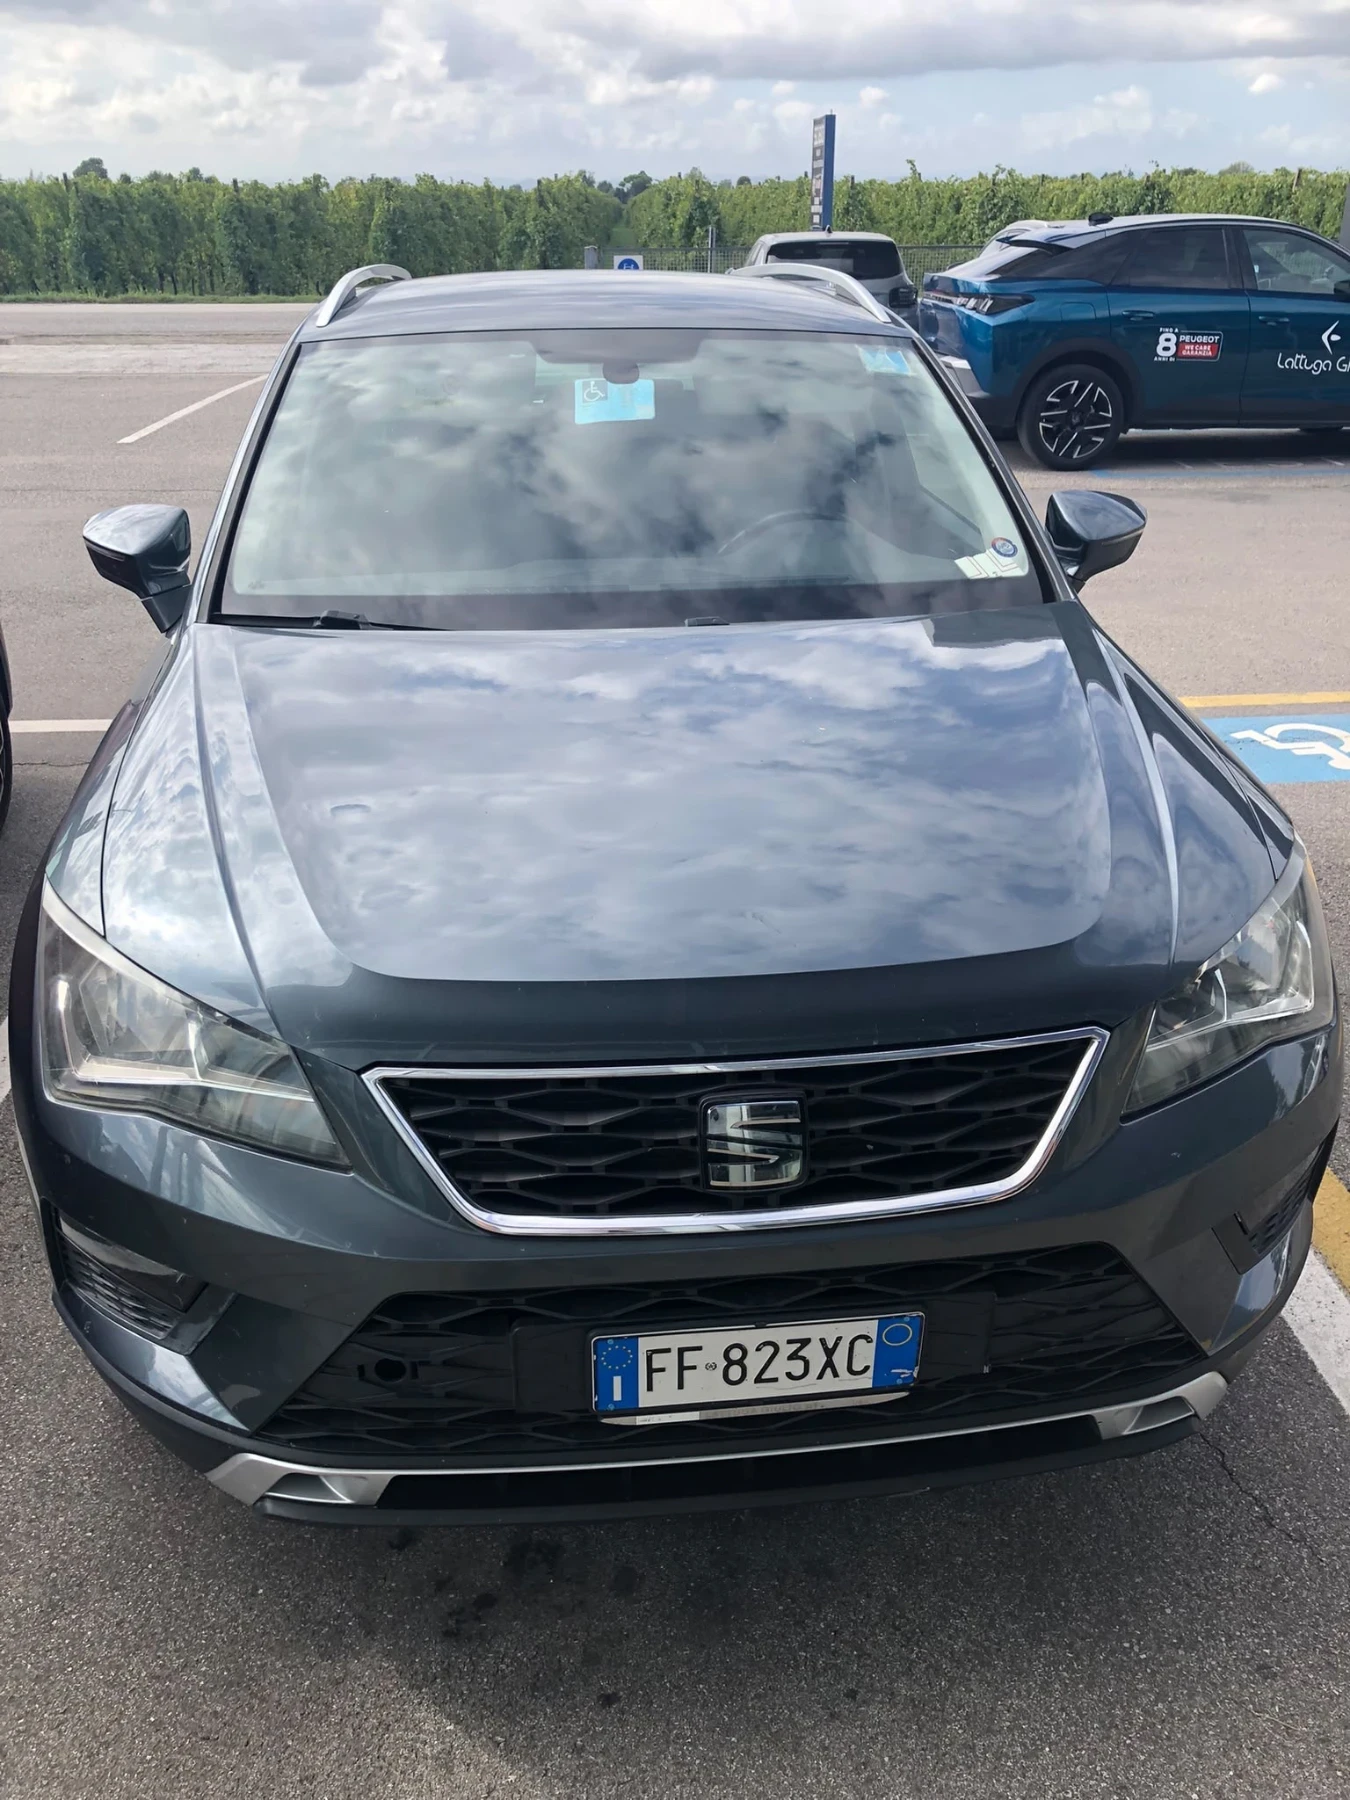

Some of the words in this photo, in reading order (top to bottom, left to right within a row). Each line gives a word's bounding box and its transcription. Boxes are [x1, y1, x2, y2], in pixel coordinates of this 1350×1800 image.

[1156, 332, 1177, 357] 8
[1180, 335, 1220, 343] PEUGEOT
[1336, 356, 1350, 372] G
[645, 1345, 703, 1392] FF
[722, 1333, 874, 1387] 823XC
